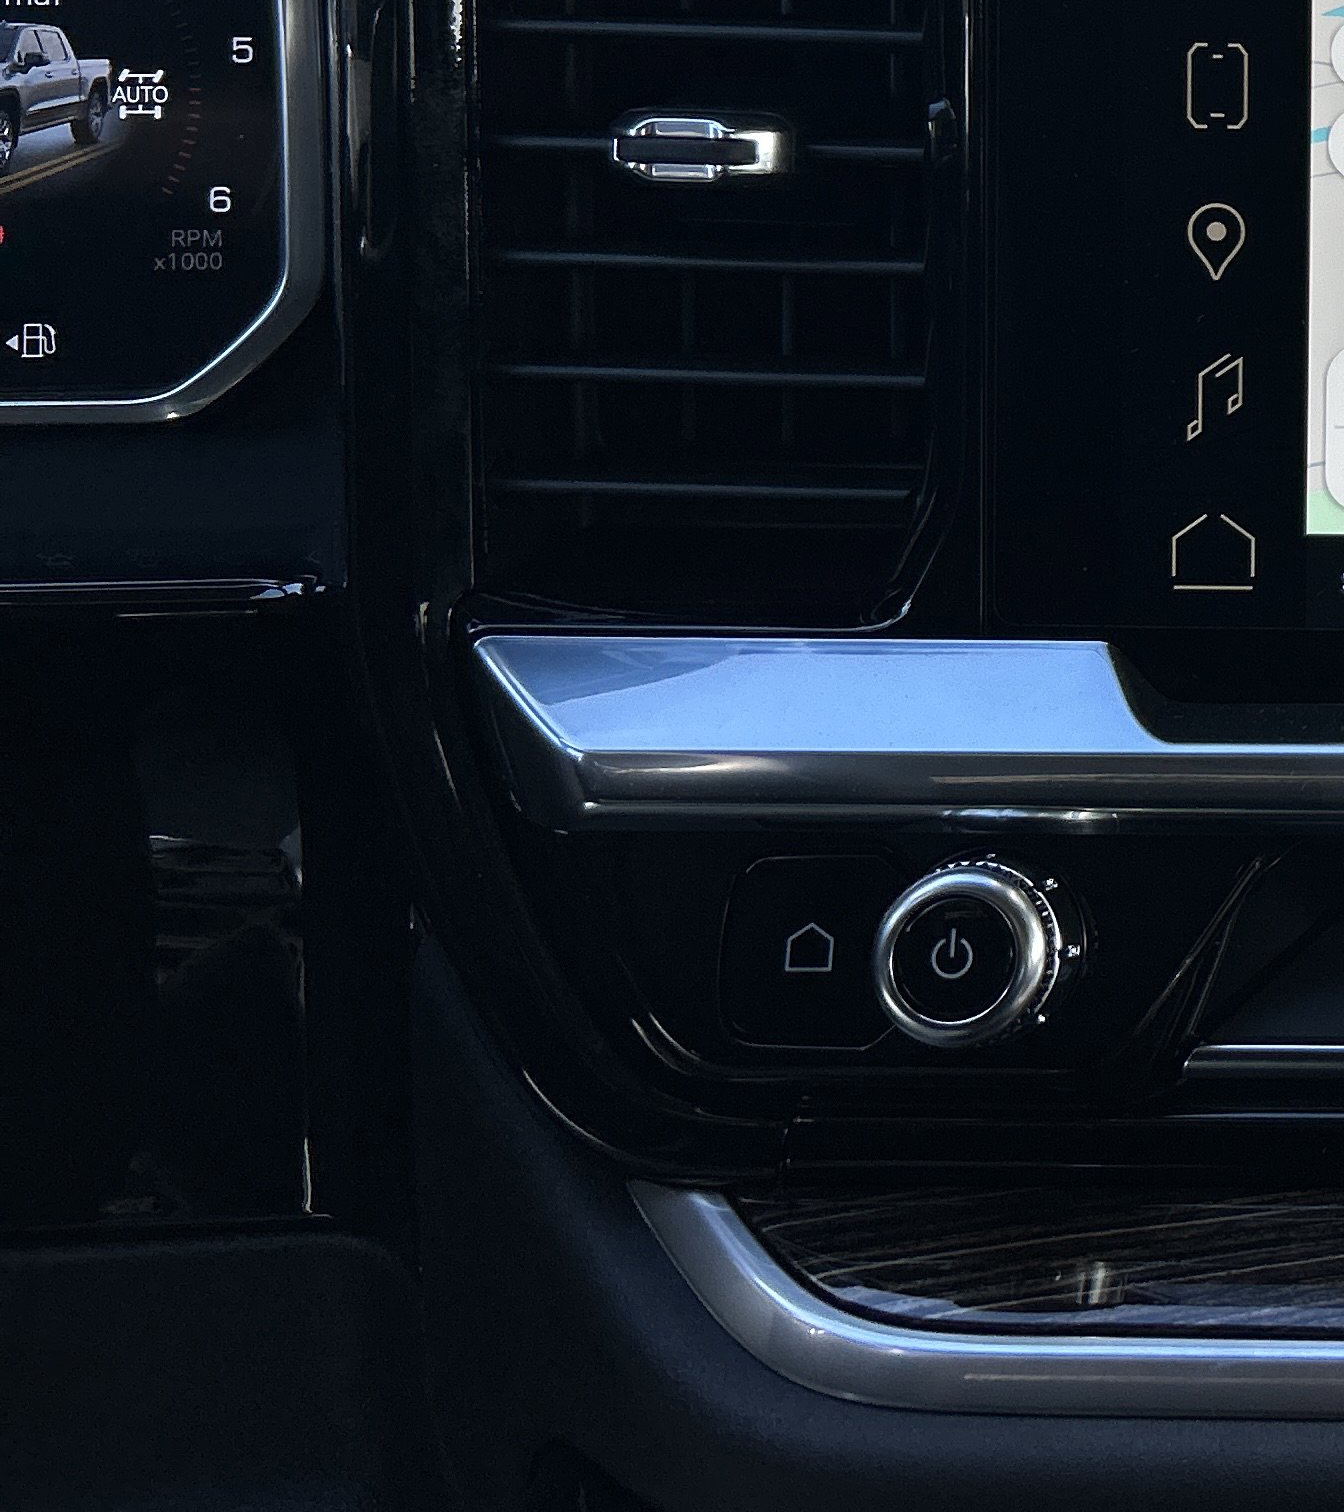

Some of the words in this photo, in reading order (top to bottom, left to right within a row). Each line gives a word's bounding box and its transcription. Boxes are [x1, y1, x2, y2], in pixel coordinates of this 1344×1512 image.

[231, 36, 254, 64] 5
[112, 85, 169, 103] AUTO
[208, 186, 232, 213] 6
[170, 229, 223, 248] RPM
[153, 251, 223, 271] x1000
